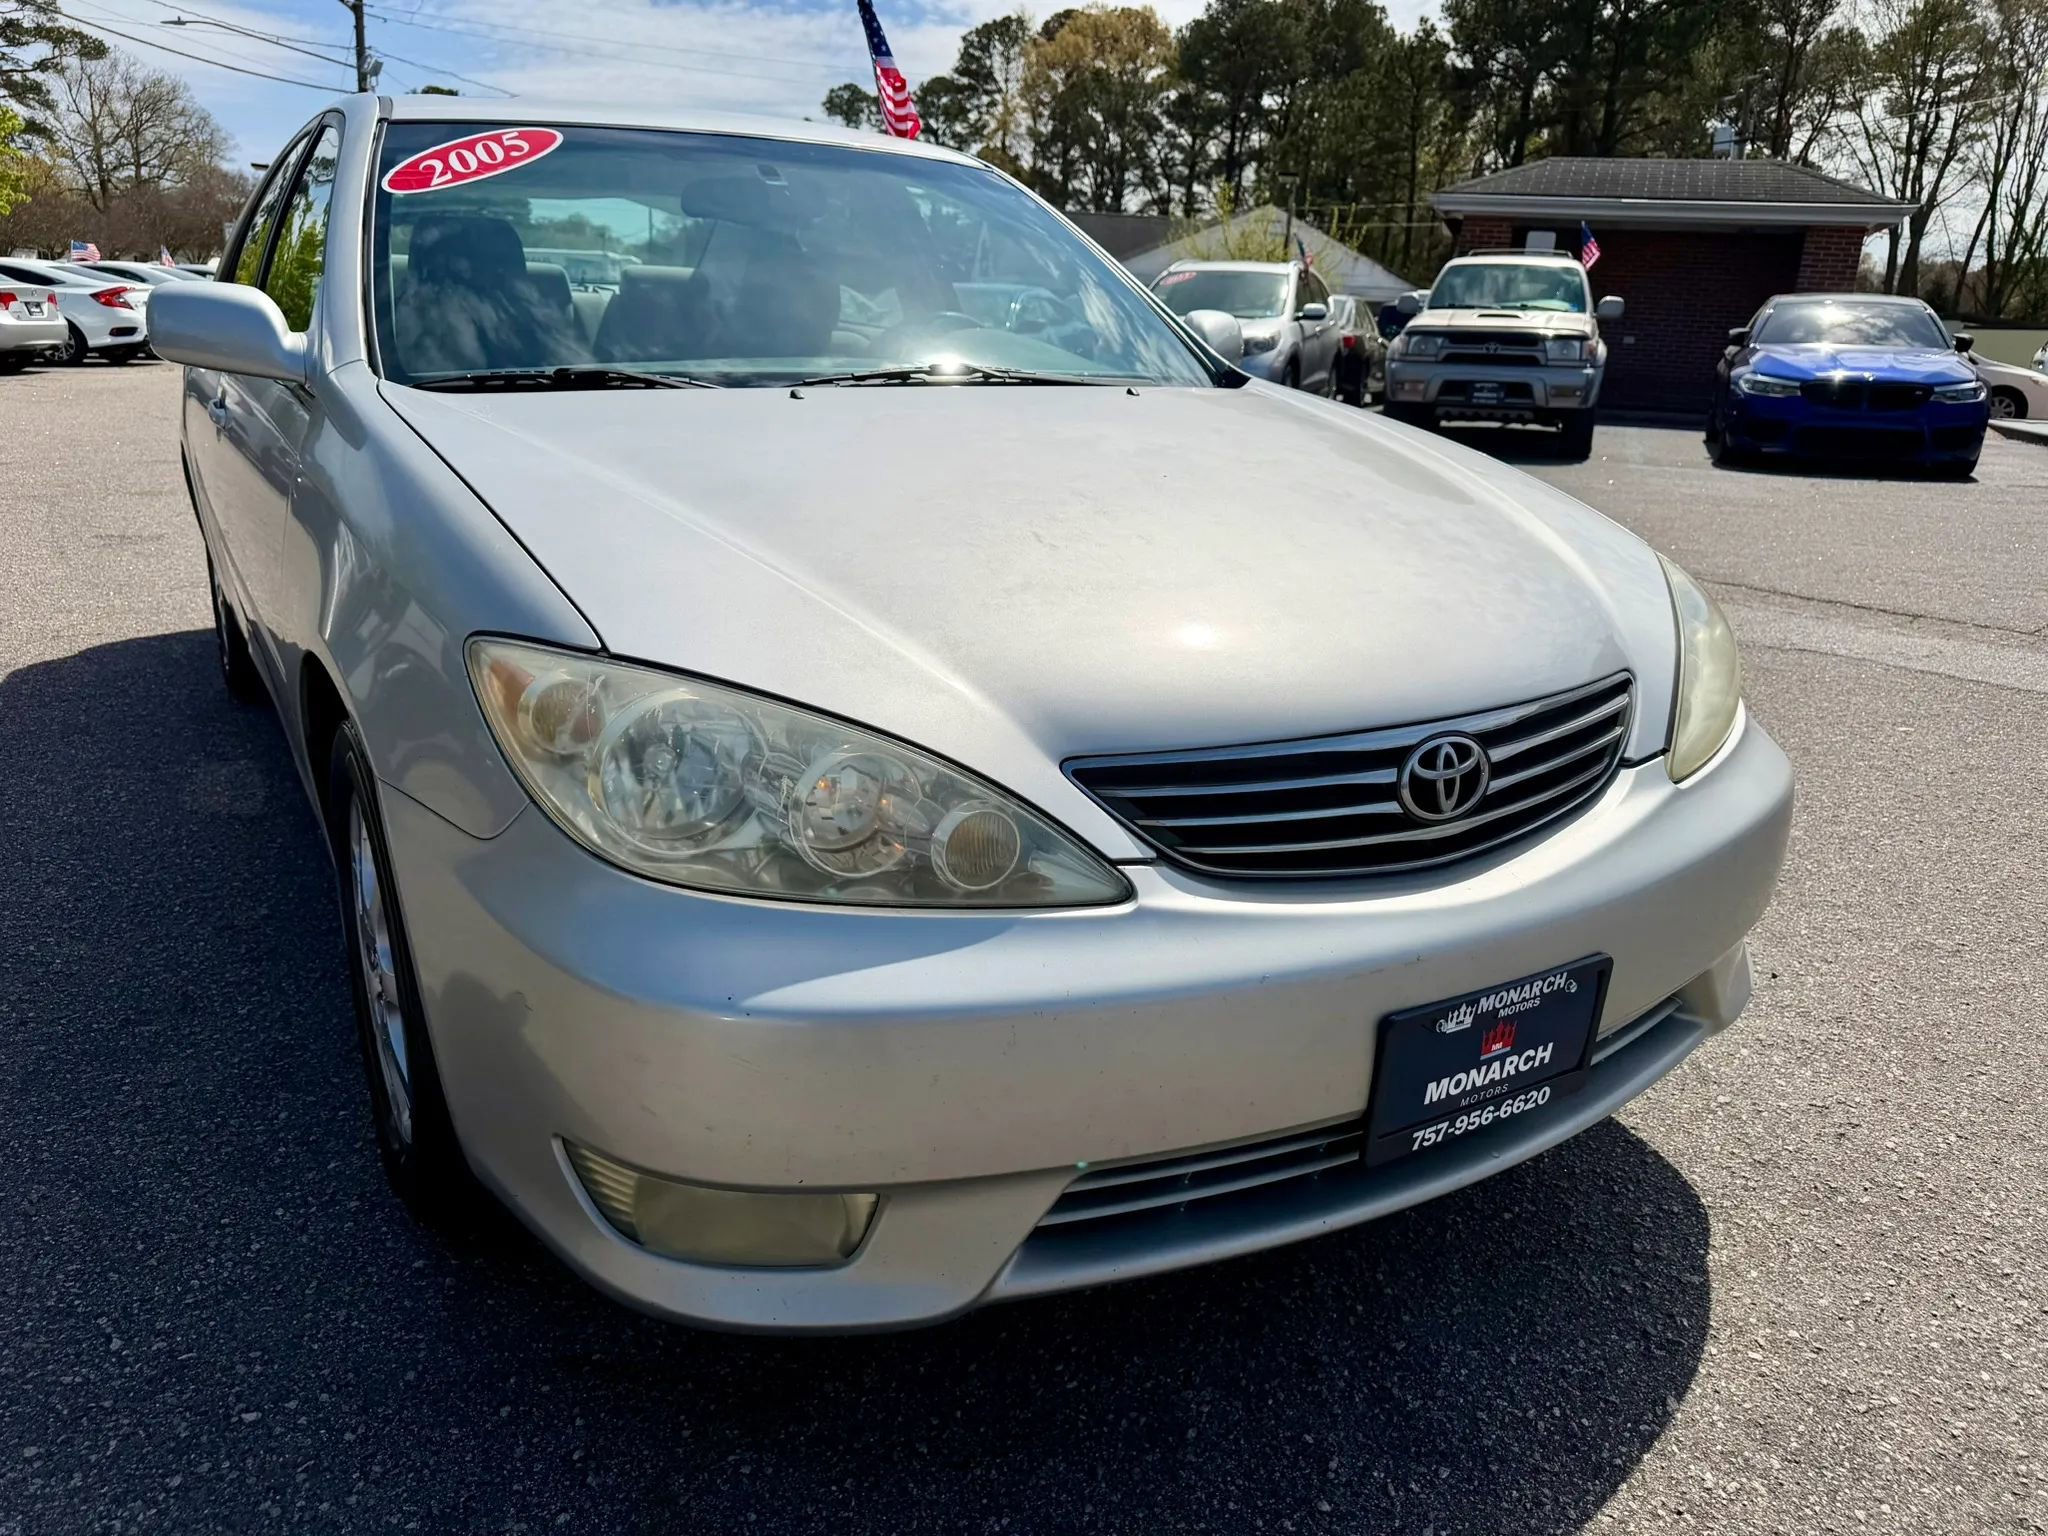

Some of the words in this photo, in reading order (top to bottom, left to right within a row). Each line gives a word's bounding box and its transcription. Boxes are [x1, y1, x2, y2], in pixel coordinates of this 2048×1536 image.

[418, 131, 530, 186] 2005
[1477, 971, 1568, 1014] MONARCH
[1497, 997, 1541, 1018] MOTORS
[1423, 1041, 1553, 1106] MONARCH
[1460, 1083, 1509, 1107] MOTORS
[1412, 1086, 1551, 1151] 757-956-6620
